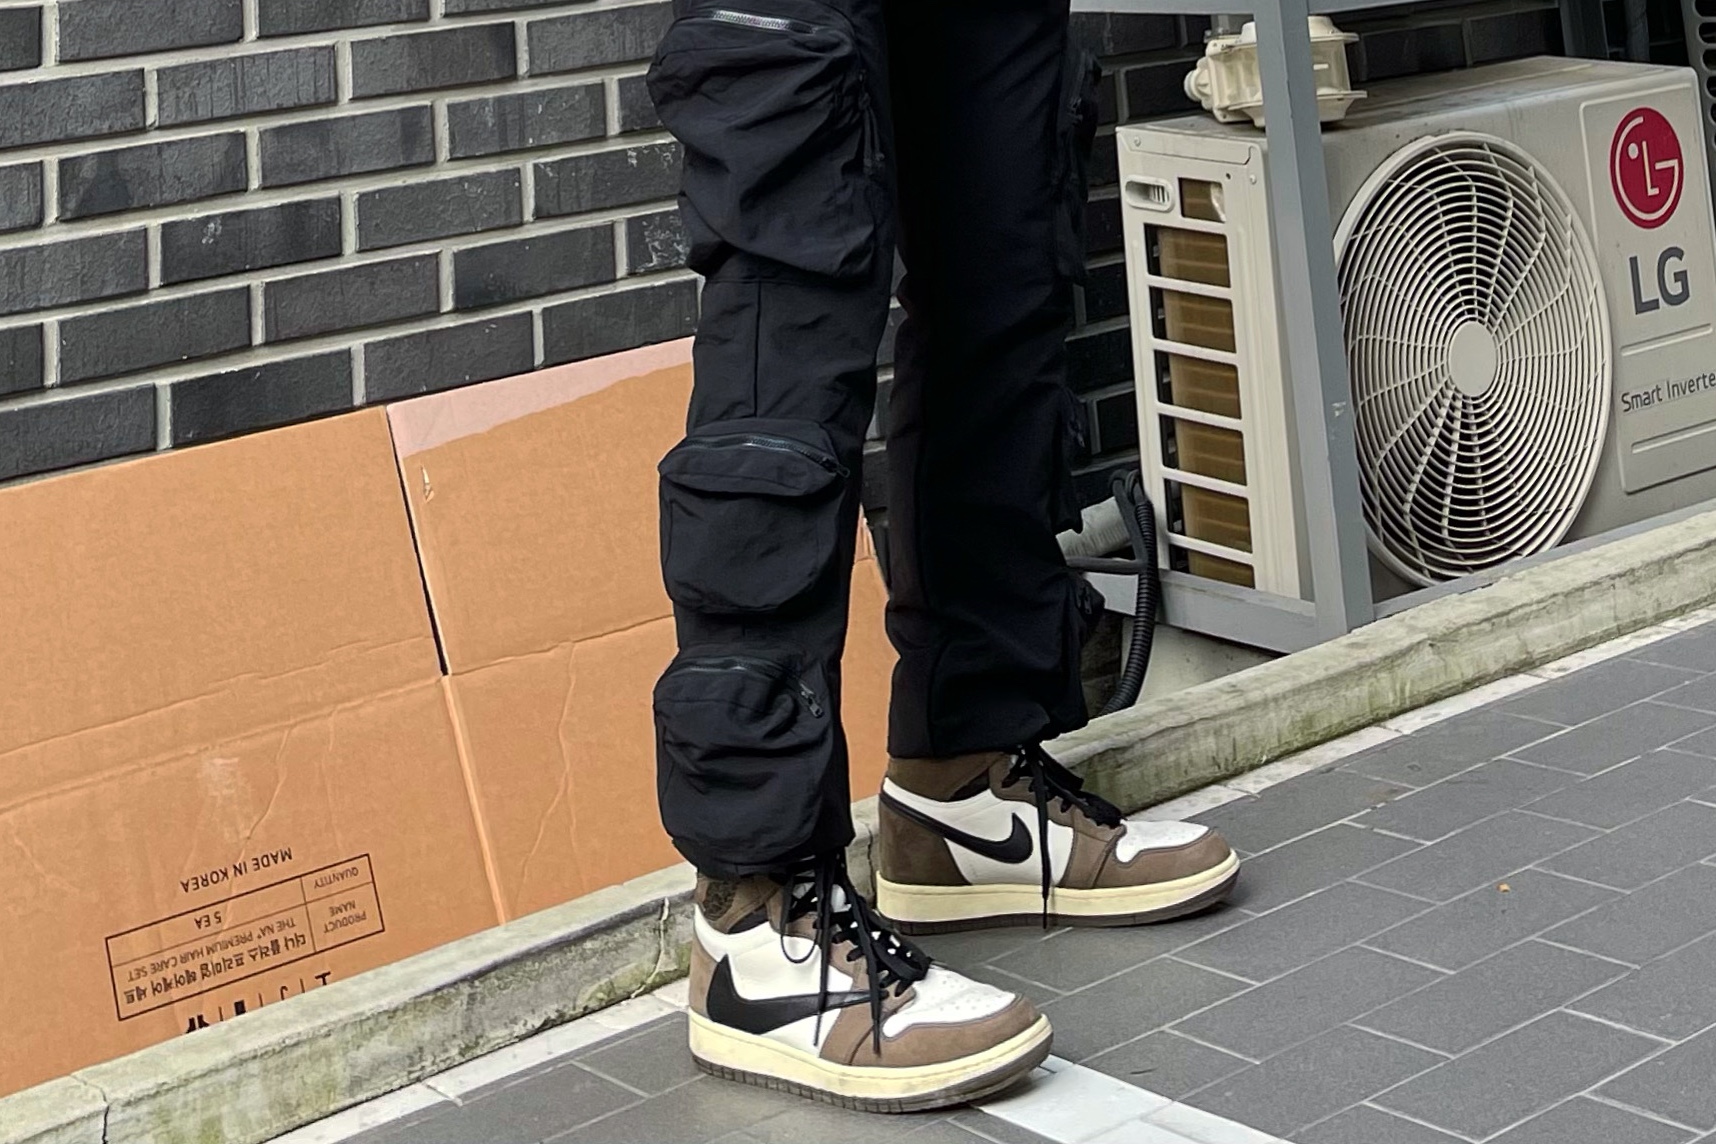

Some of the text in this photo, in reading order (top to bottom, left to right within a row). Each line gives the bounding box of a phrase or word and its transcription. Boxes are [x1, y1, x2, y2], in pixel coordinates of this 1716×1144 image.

[1628, 245, 1691, 316] LG
[1621, 384, 1663, 412] Smart
[180, 847, 293, 893] MADE IN KOREA
[313, 866, 359, 889] QUANTITY
[329, 900, 356, 917] NAME
[194, 911, 222, 930] 5 EA
[276, 917, 297, 933] THE
[323, 910, 367, 933] PRODUCT
[205, 931, 254, 956] PREMIUM
[150, 956, 178, 975] CARE
[179, 948, 204, 965] HAIR
[127, 966, 148, 983] SET
